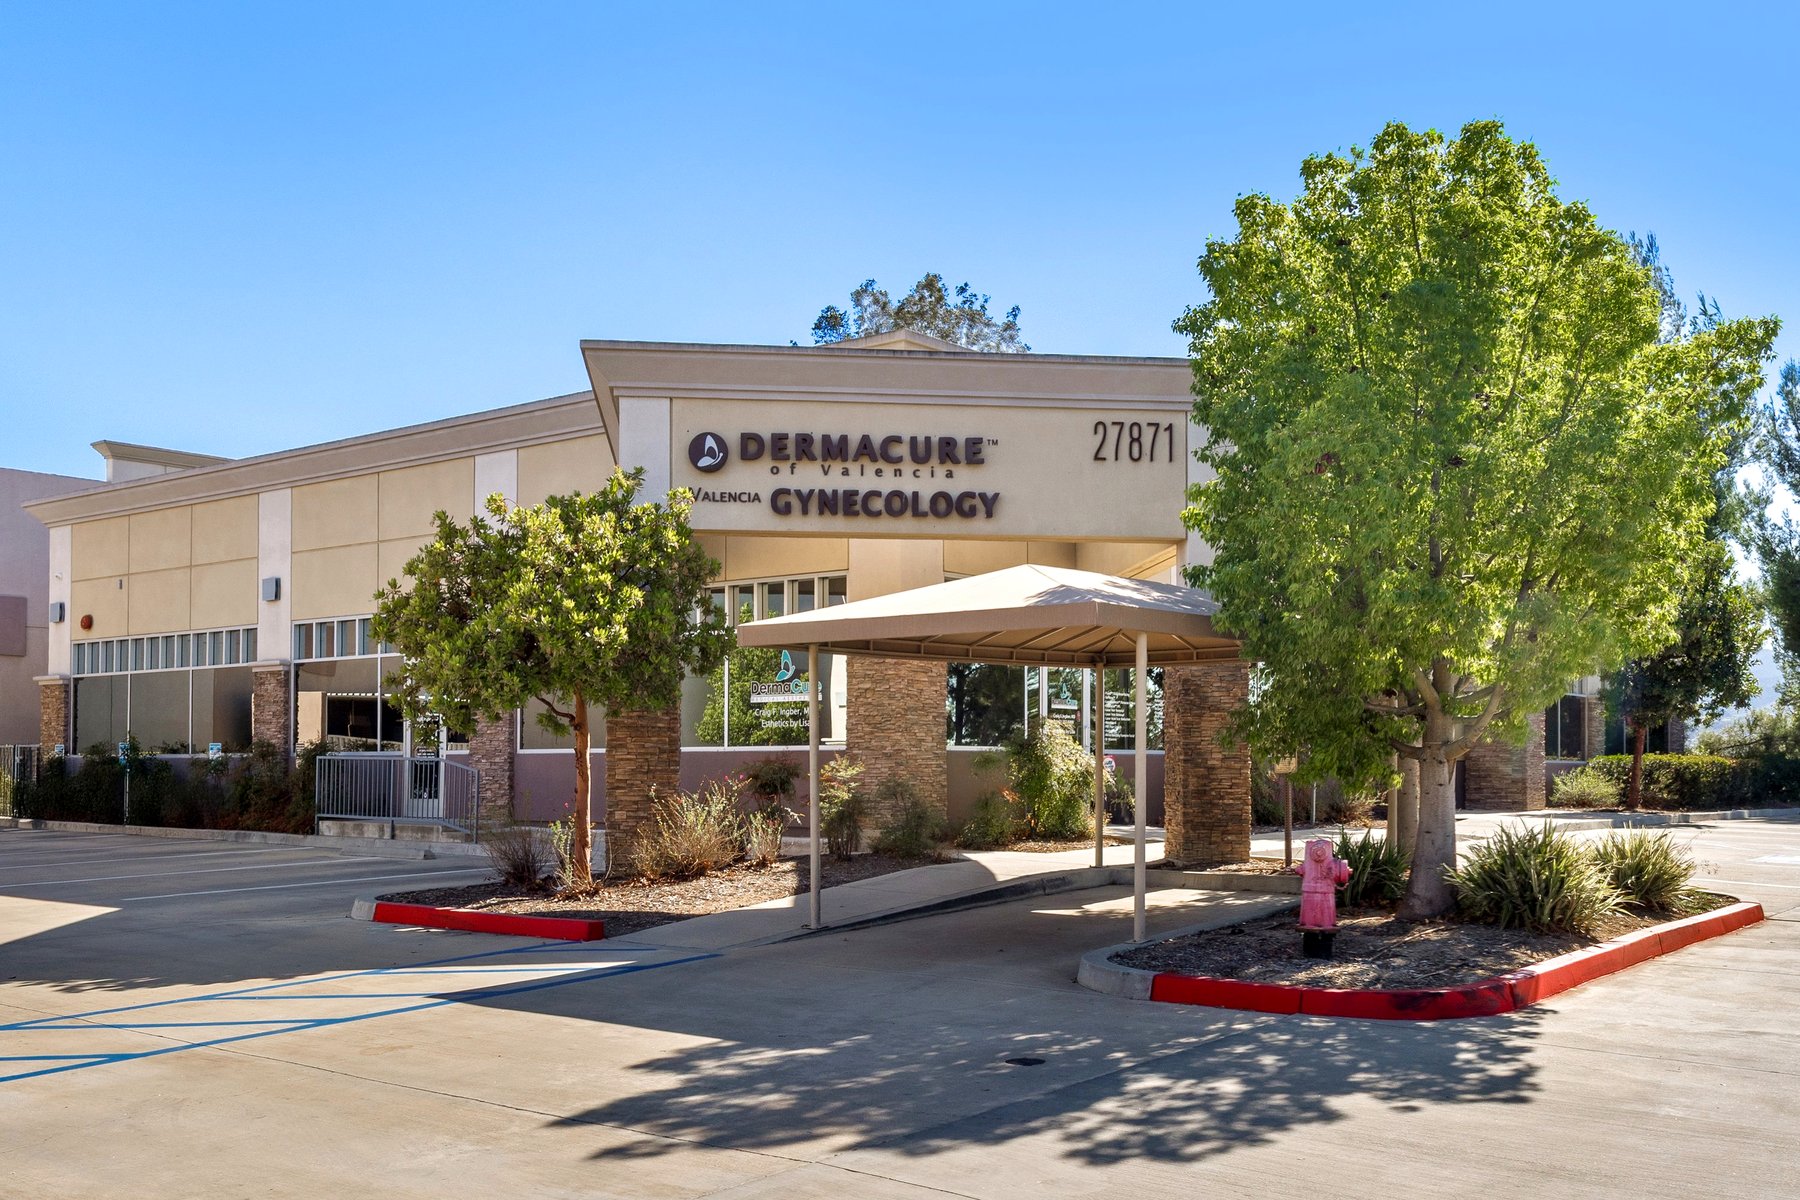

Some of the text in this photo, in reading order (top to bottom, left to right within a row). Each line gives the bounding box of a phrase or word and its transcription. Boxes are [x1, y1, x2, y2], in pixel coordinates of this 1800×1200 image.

[740, 432, 985, 464] DERMACURE
[1093, 421, 1173, 462] 27871
[770, 463, 954, 478] of Valencia
[770, 488, 1000, 518] GYNECOLOGY
[789, 719, 798, 728] by
